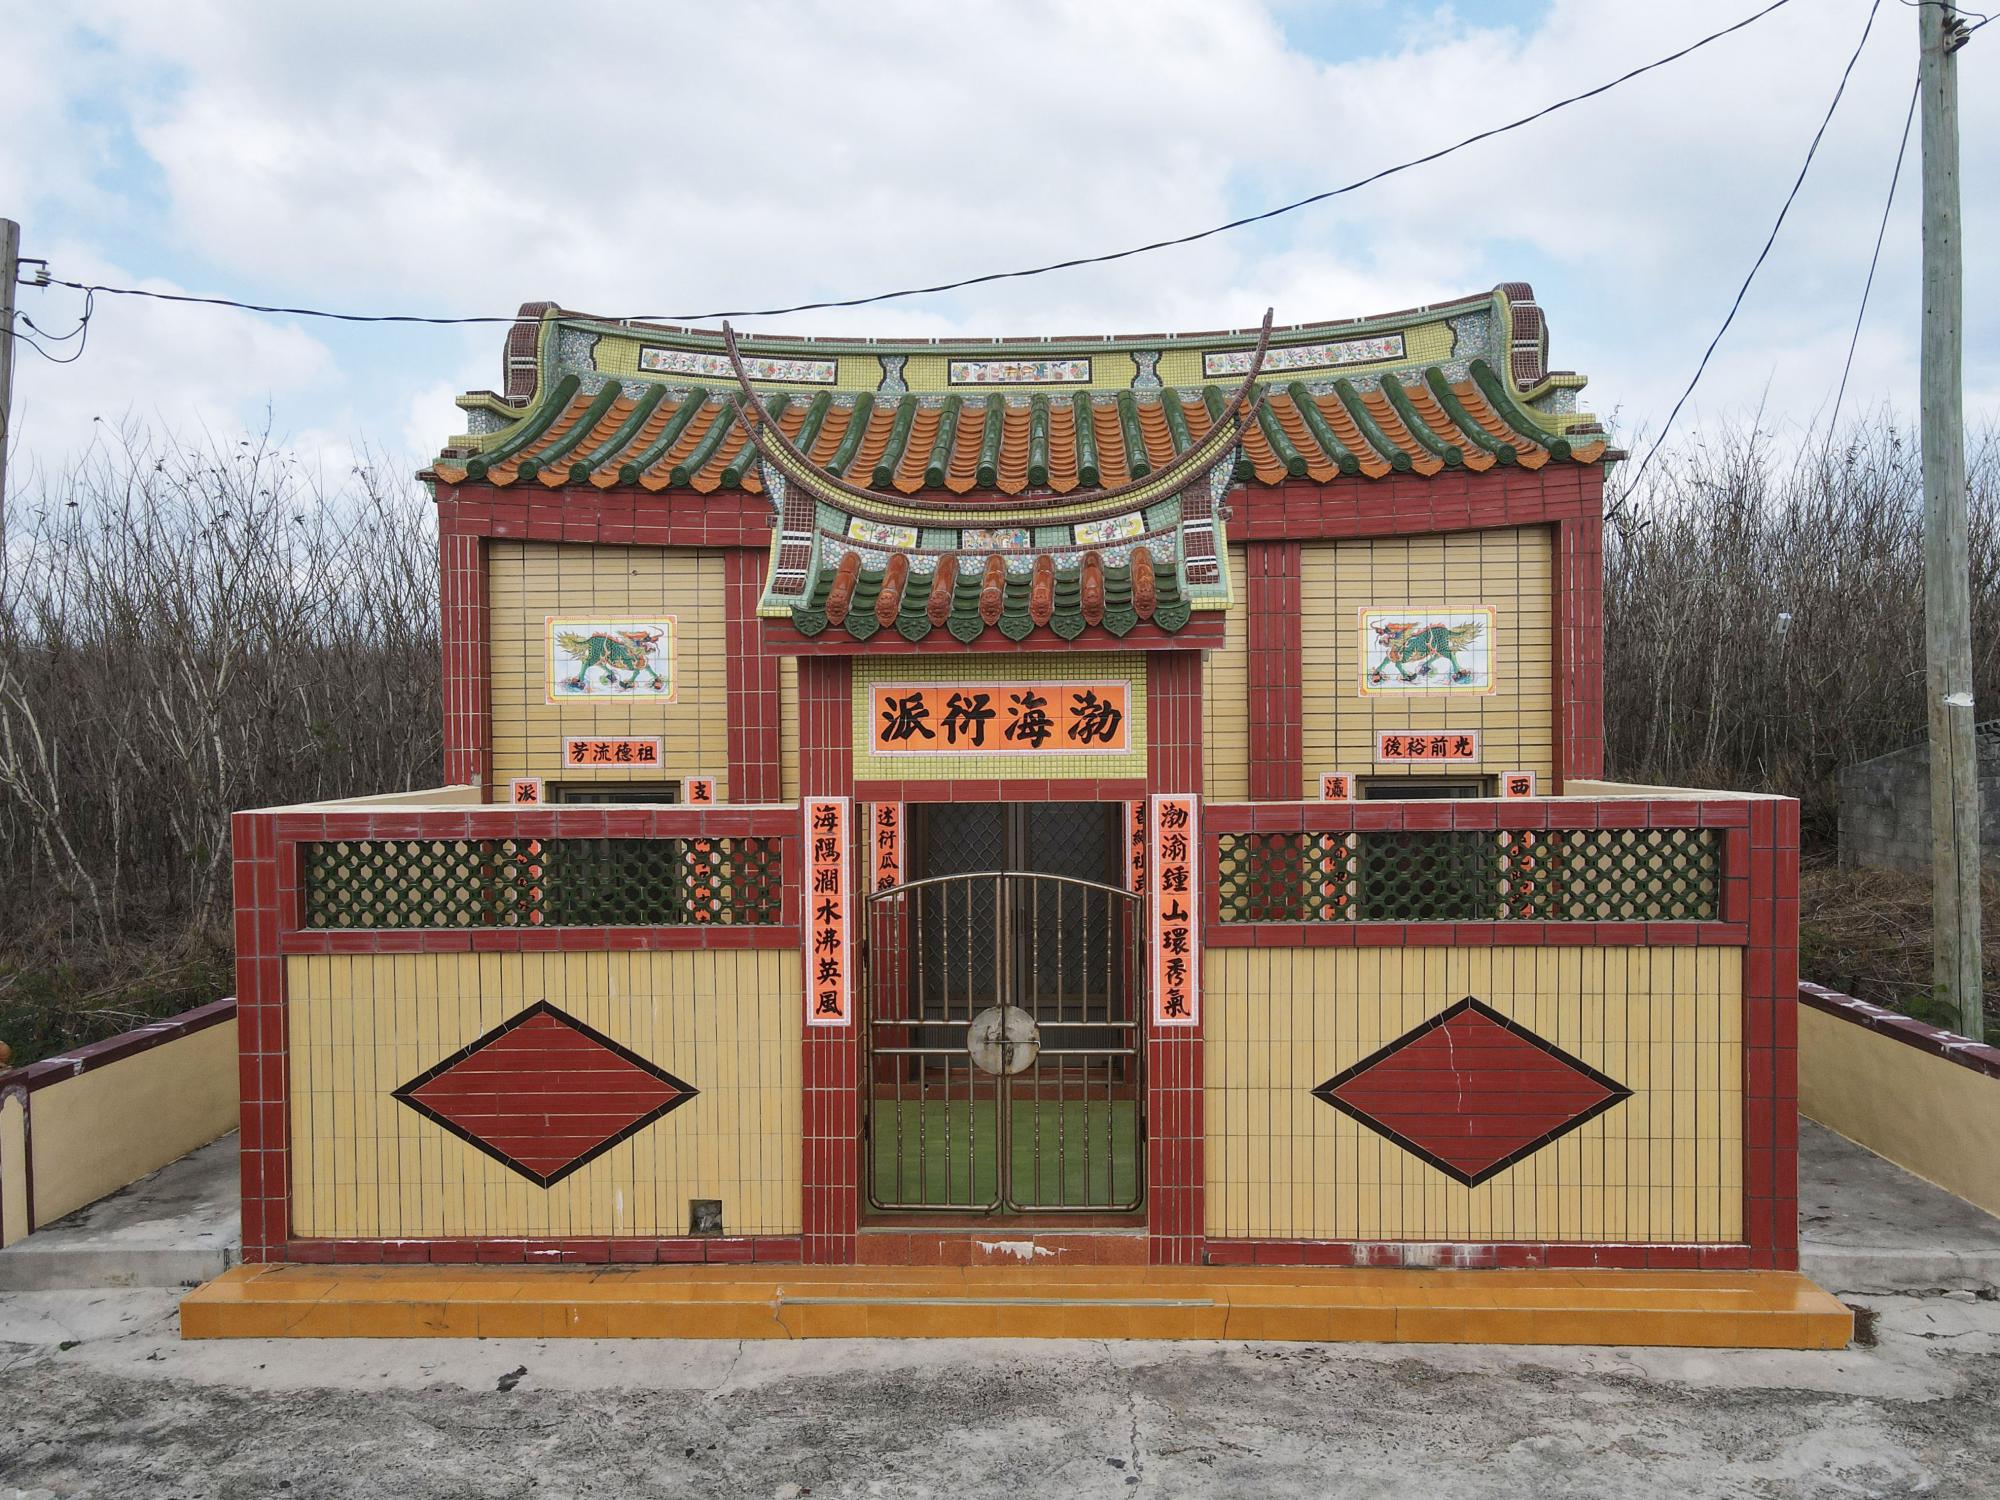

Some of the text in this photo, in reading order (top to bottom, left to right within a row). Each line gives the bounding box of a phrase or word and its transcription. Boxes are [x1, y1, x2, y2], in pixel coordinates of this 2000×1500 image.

[571, 742, 656, 763] 祖德流芳
[1384, 736, 1473, 757] 光前裕後
